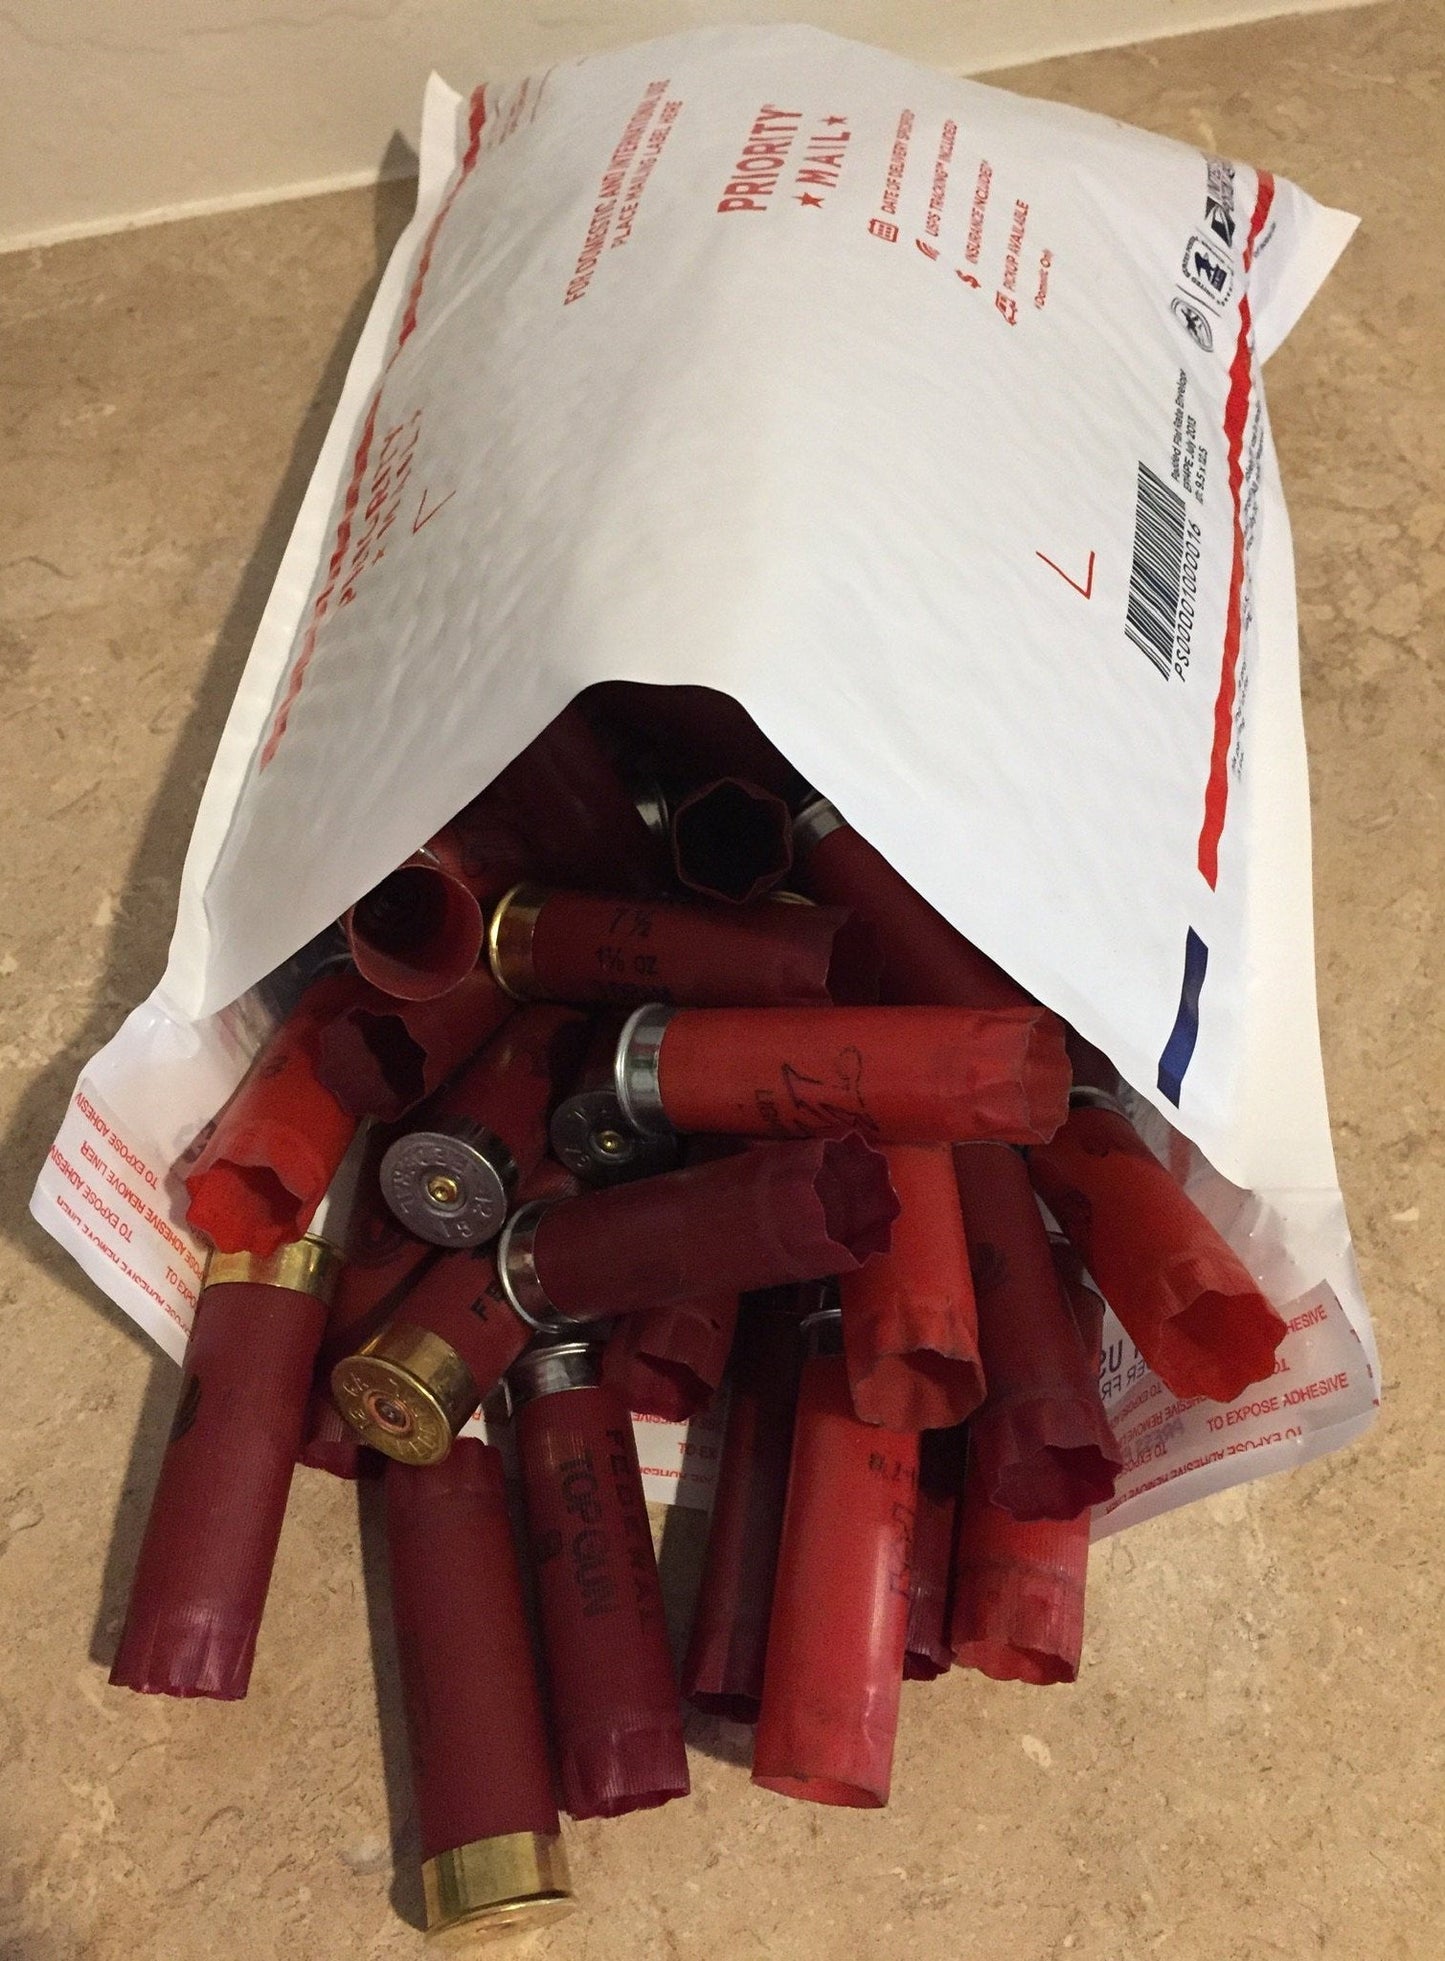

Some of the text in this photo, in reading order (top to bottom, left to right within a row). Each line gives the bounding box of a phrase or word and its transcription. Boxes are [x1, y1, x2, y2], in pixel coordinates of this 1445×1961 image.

[717, 107, 802, 213] PRIORITY
[795, 132, 851, 188] MAIL
[611, 202, 639, 249] PLACE
[881, 189, 899, 215] DATE
[925, 211, 941, 237] USPS
[575, 199, 617, 274] DOMESTIC
[965, 208, 985, 264] INSURANCE
[1003, 199, 1029, 292] PICKUP AVAILABLE
[563, 270, 594, 305] FOR
[1173, 408, 1184, 429] Rate
[1170, 446, 1182, 482] Padded
[1185, 440, 1196, 459] July
[1174, 519, 1202, 683] PS00001000016
[75, 1092, 158, 1191] TO EXPOSE ADHESIV
[80, 1140, 108, 1176] LINER
[49, 1144, 133, 1244] TO EXPOSE ADHESIV
[106, 1170, 146, 1214] REMOVE
[144, 1207, 187, 1256] ADHESIVE
[164, 1266, 178, 1286] TO
[1286, 1304, 1328, 1335] HESIVE
[1206, 1416, 1225, 1433] TO
[1226, 1397, 1280, 1427] EXPOSE
[1283, 1372, 1349, 1408] ADHESIVE
